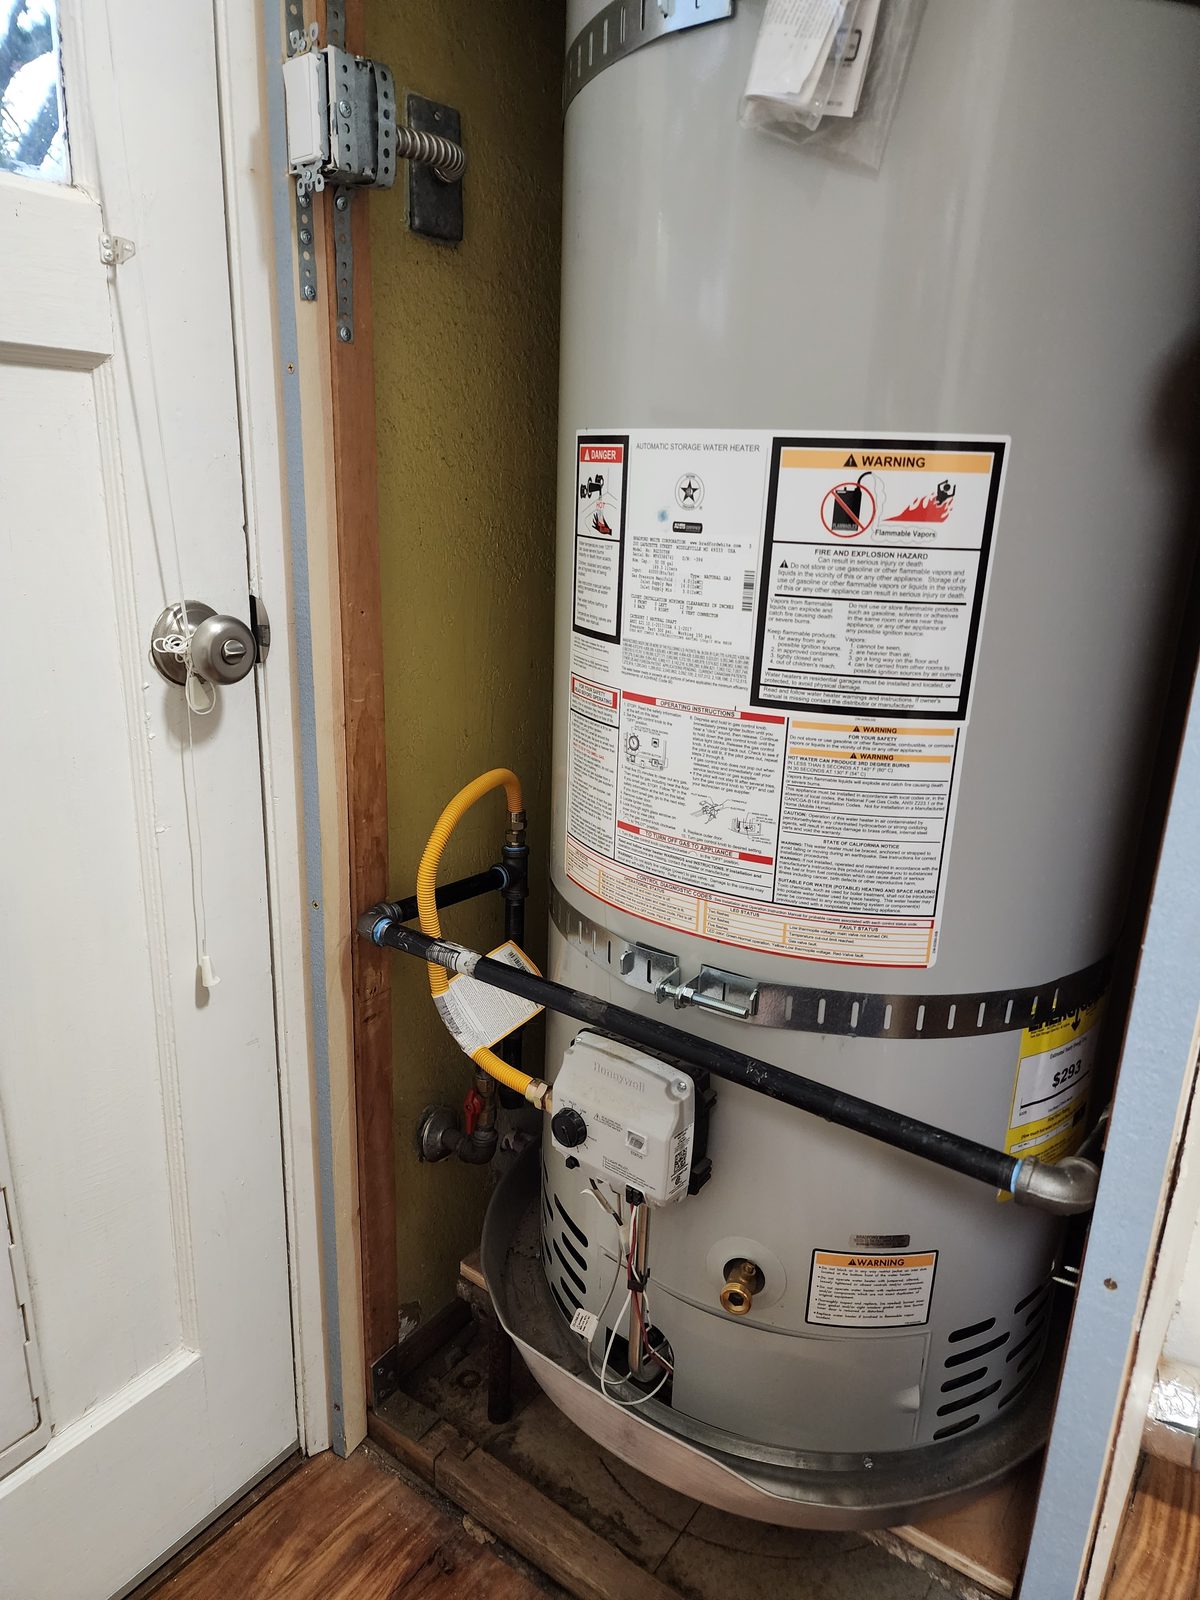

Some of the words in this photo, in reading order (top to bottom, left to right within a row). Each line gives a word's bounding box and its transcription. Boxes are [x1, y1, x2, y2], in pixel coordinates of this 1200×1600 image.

[591, 450, 616, 460] DANGER
[862, 457, 925, 468] WARNING
[875, 528, 911, 537] Flammable
[912, 529, 935, 539] Vapors
[847, 565, 872, 574] gasoline
[778, 570, 796, 578] liquids
[814, 572, 834, 580] vicinity
[928, 576, 950, 584] Storage
[796, 578, 820, 586] gasoline
[908, 583, 927, 591] liquids
[830, 587, 859, 595] appliance
[660, 700, 690, 710] OPERATING
[691, 705, 735, 717] INSTRUCTIONS
[653, 833, 666, 842] TURN
[667, 836, 677, 844] OFF
[678, 839, 690, 847] GAS
[700, 844, 731, 857] APPLIANCE
[637, 874, 658, 886] CONTROL
[660, 881, 691, 895] DIAGNOSTIC
[692, 890, 712, 900] CODES
[1052, 1060, 1081, 1088] $293
[630, 1150, 643, 1159] STATUS
